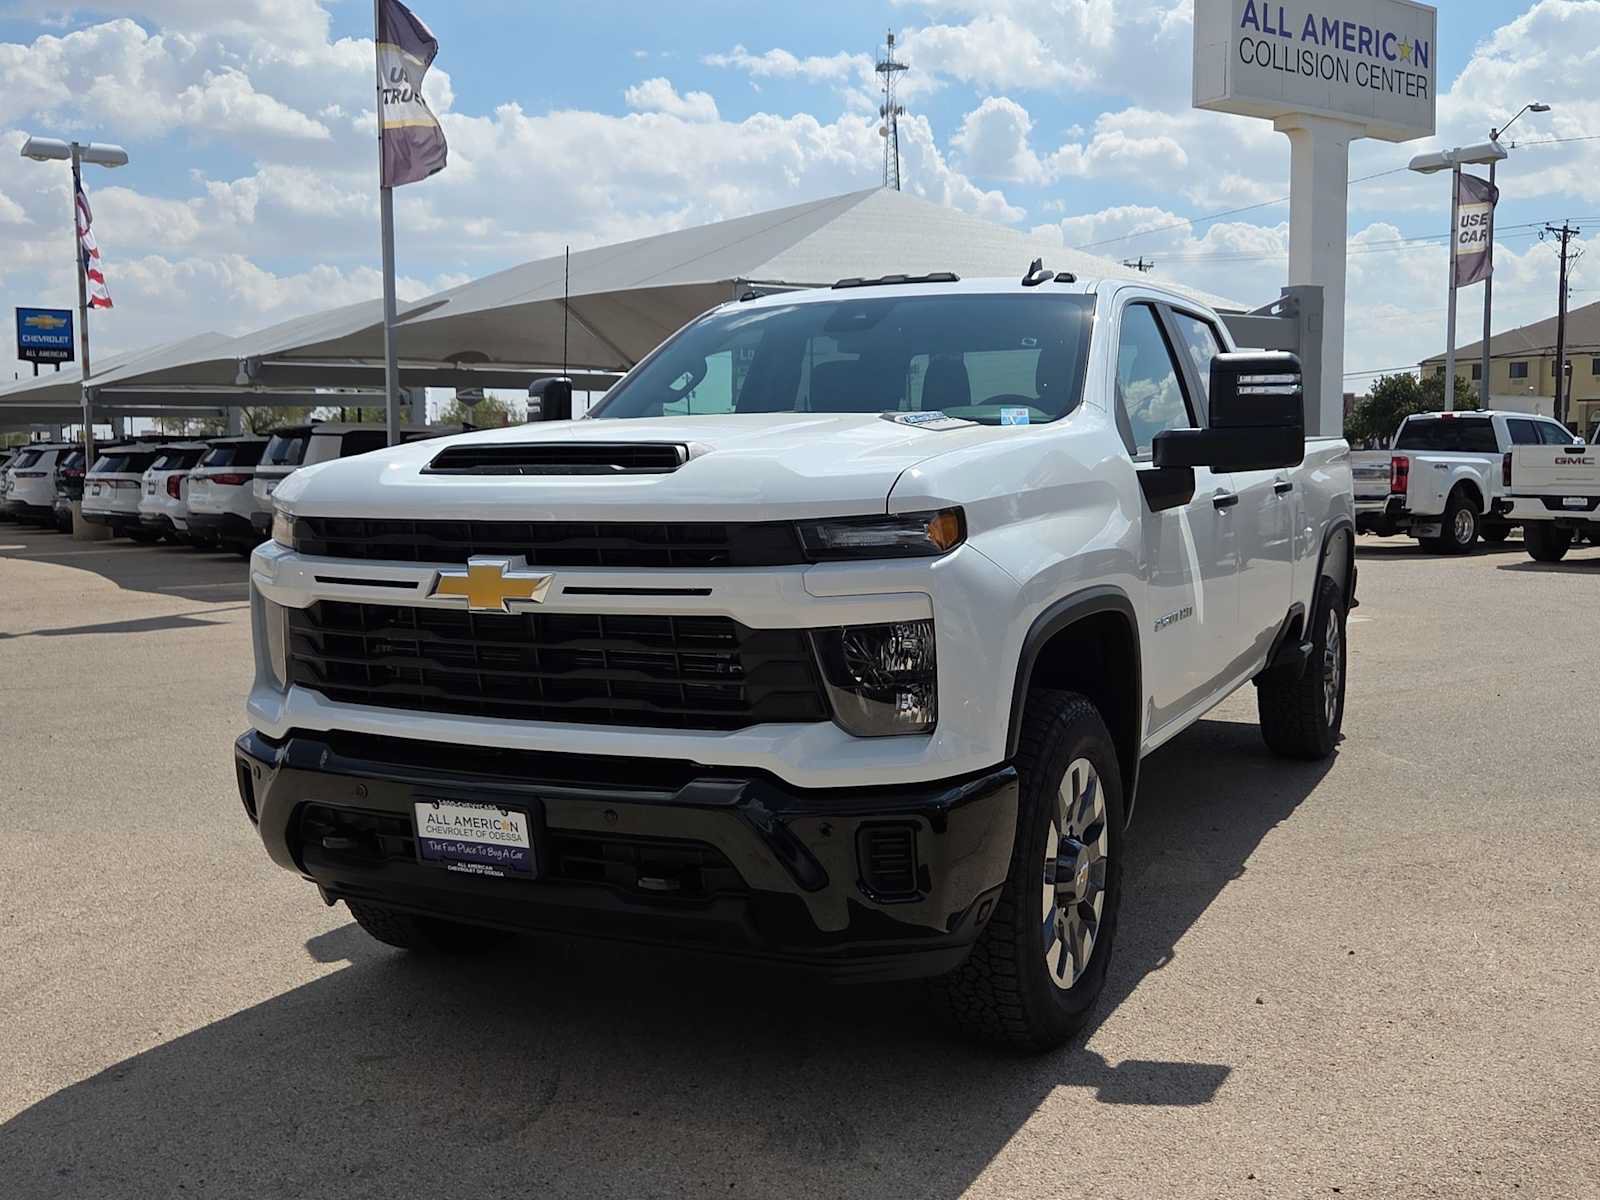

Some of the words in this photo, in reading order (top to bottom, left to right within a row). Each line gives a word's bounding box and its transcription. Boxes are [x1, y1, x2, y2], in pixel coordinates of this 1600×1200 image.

[1240, 0, 1292, 38] ALL
[1301, 13, 1428, 69] AMERICN
[1239, 37, 1349, 83] COLLISION
[1355, 62, 1428, 100] CENTER
[22, 334, 69, 344] CHEVROLET
[26, 349, 37, 357] ALL
[38, 350, 68, 358] AMERICAN
[1554, 457, 1595, 465] GMC
[427, 813, 450, 825] ALL
[454, 816, 519, 833] AMERICN
[426, 825, 473, 837] CHEVROLET
[475, 829, 487, 838] OF
[488, 831, 523, 842] ODESSA
[428, 840, 441, 851] The
[457, 842, 477, 854] Place
[477, 845, 487, 856] To
[503, 848, 510, 858] A
[510, 849, 523, 859] Car
